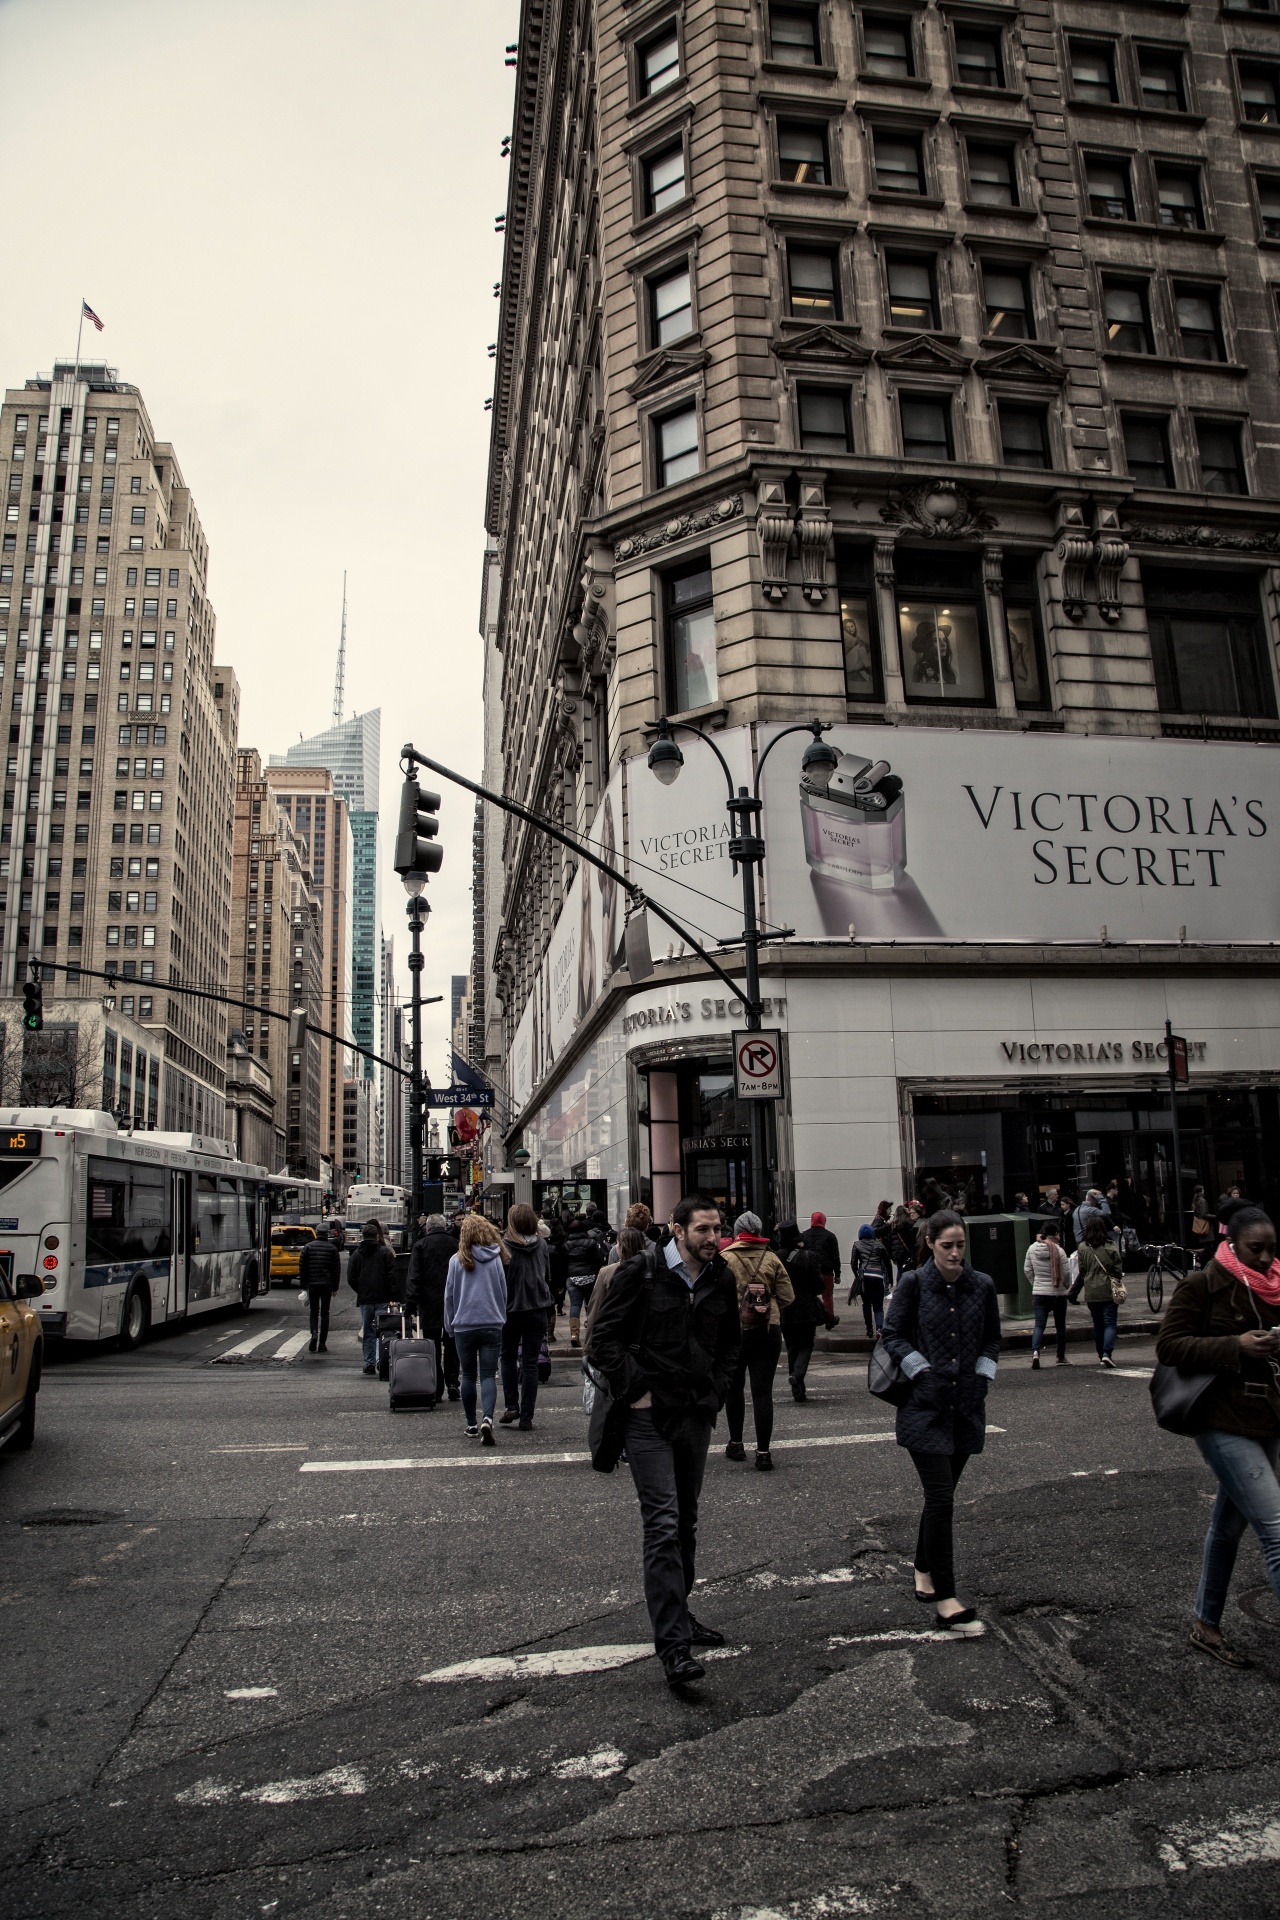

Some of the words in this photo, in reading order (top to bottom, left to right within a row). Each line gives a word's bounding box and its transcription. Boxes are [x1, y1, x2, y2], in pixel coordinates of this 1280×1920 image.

[960, 784, 1267, 837] VICTORIA'S
[822, 828, 861, 844] VICTORIA'S
[830, 836, 855, 848] SECRET
[659, 841, 727, 871] SECRET
[1032, 839, 1226, 887] SECRET
[701, 997, 788, 1019] SECET
[1000, 1041, 1123, 1061] VICTORIA'S
[1132, 1040, 1207, 1060] SECET
[434, 1093, 458, 1103] West
[460, 1092, 477, 1103] 34th
[479, 1093, 489, 1103] St
[134, 1146, 144, 1156] NEW
[145, 1148, 161, 1159] SEASON
